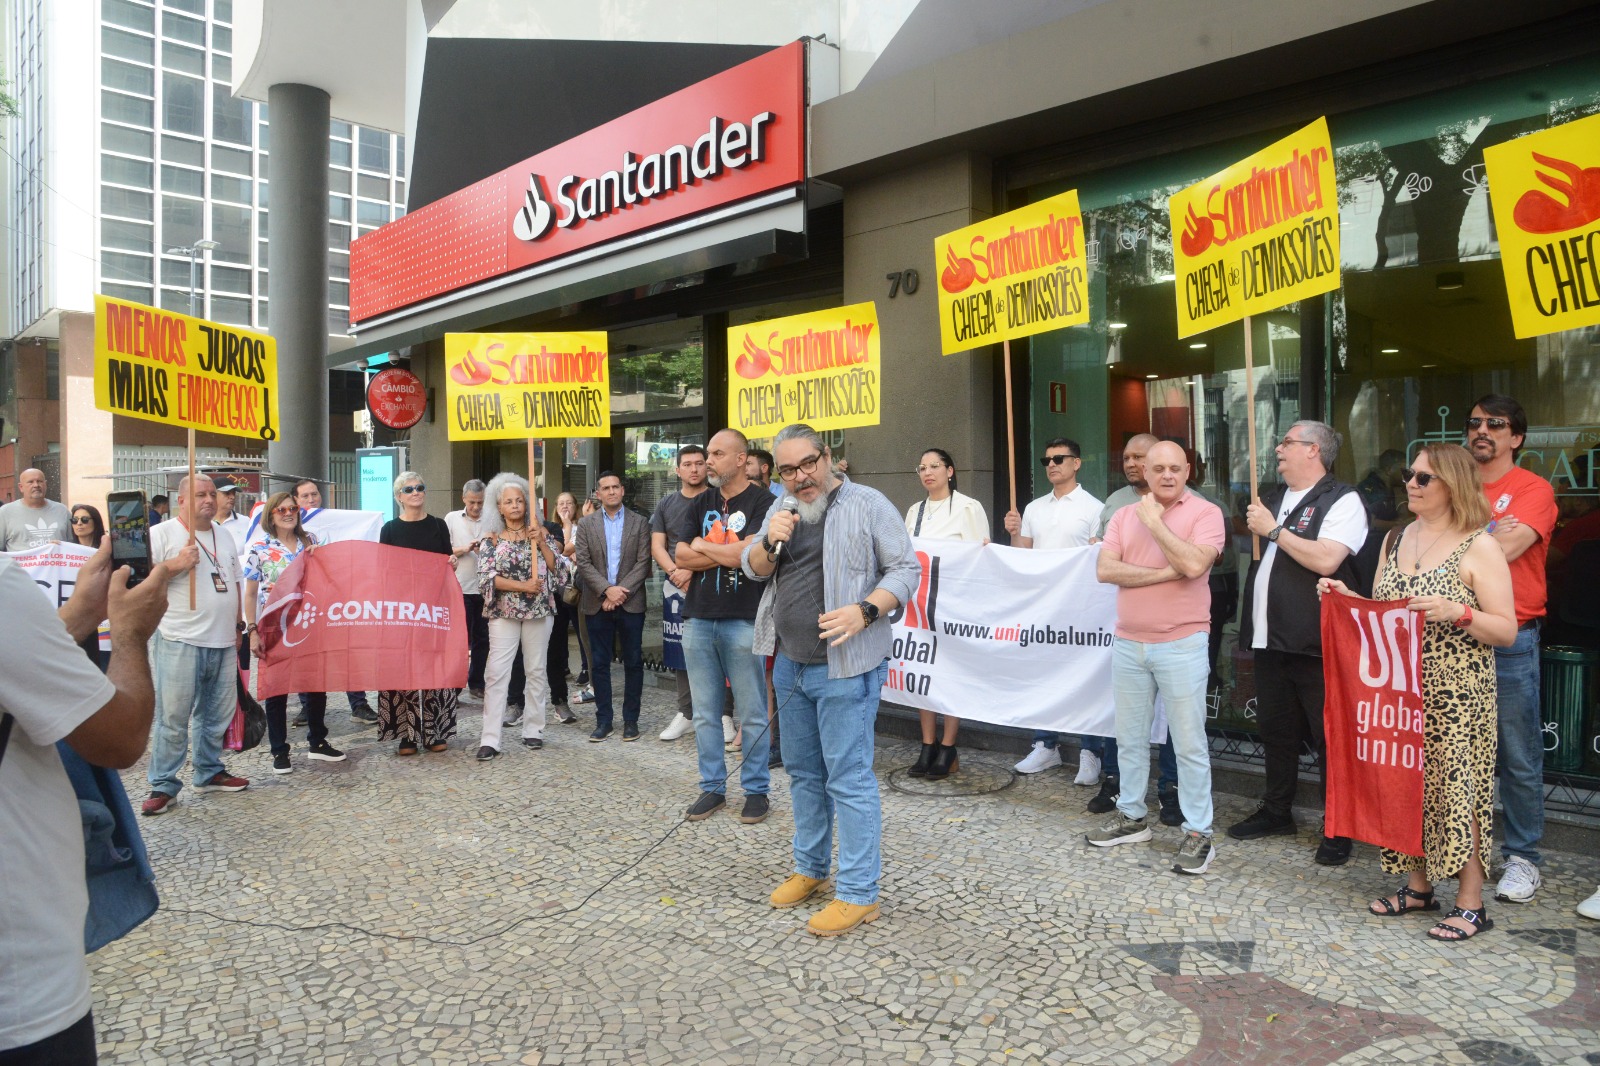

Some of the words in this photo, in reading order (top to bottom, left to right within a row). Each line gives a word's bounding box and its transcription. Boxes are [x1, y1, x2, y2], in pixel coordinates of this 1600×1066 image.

[557, 111, 774, 229] Santander
[1206, 146, 1328, 247] Santander
[970, 213, 1081, 284] Santander
[1186, 259, 1230, 320] CHEGA
[1228, 267, 1240, 286] de
[1242, 216, 1335, 300] DEMISSÕES
[886, 269, 919, 298] 70
[952, 290, 997, 342] CHEGA
[995, 297, 1005, 314] de
[1006, 265, 1082, 329] DEMISSÕES
[106, 302, 187, 367] MENOS
[197, 325, 266, 384] JUROS
[486, 343, 607, 385] Santander
[768, 319, 874, 377] Santander
[108, 358, 168, 417] MAIS
[380, 402, 416, 411] EXCHANGE
[381, 382, 415, 393] CÂMBIO
[738, 383, 785, 428] CHEGA
[797, 367, 876, 421] DEMISSÕES
[375, 409, 391, 424] DOLLAR
[393, 410, 423, 427] WITHDRAWAL
[457, 393, 504, 432] CHEGA
[506, 402, 519, 416] DE
[523, 386, 603, 429] DEMISSÕES
[1530, 431, 1600, 444] convers
[29, 538, 51, 548] adid
[327, 600, 443, 624] CONTRAF
[892, 632, 937, 665] obal
[884, 662, 931, 697] nion
[1356, 692, 1422, 734] globa
